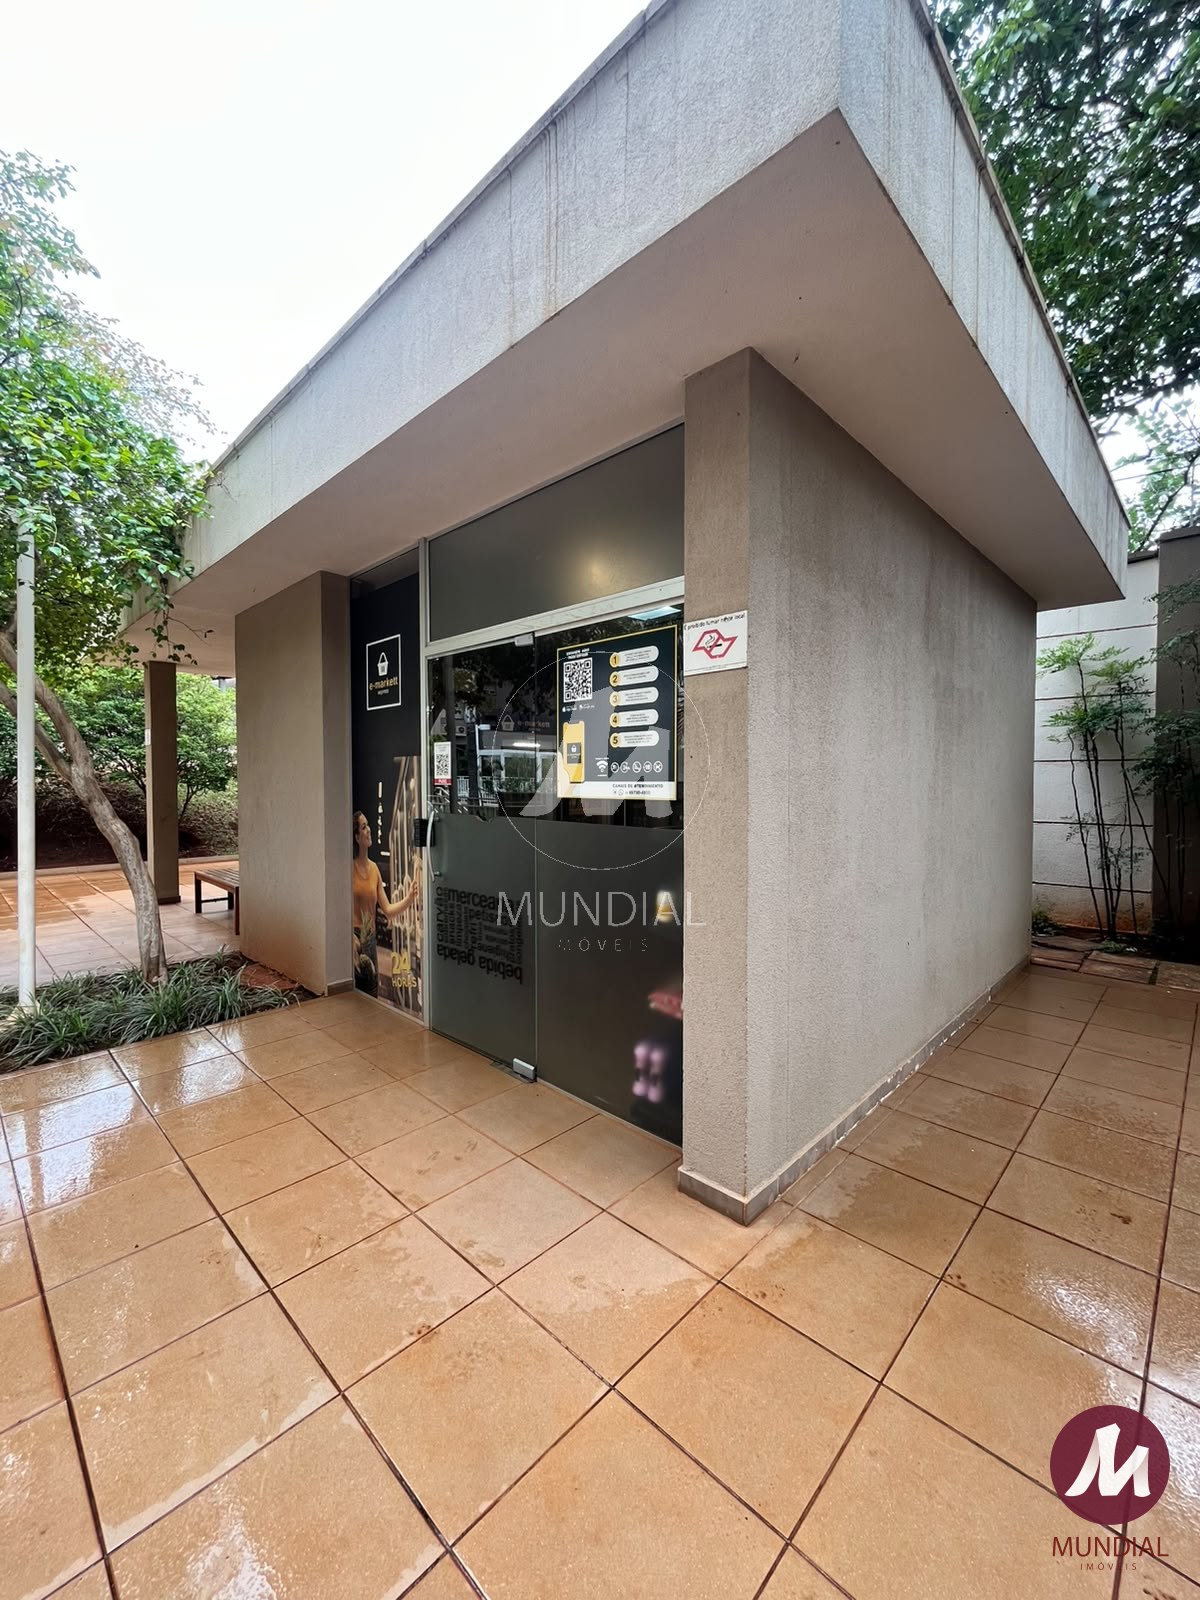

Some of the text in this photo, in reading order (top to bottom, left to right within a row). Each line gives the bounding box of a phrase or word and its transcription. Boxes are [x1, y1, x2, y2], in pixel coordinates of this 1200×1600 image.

[612, 674, 618, 683] 2
[612, 694, 618, 703] 3
[612, 715, 618, 723] 4
[613, 736, 618, 744] 5
[437, 944, 475, 966] gelada
[391, 951, 410, 974] 24
[478, 956, 523, 985] bebida
[392, 977, 417, 988] HORAS
